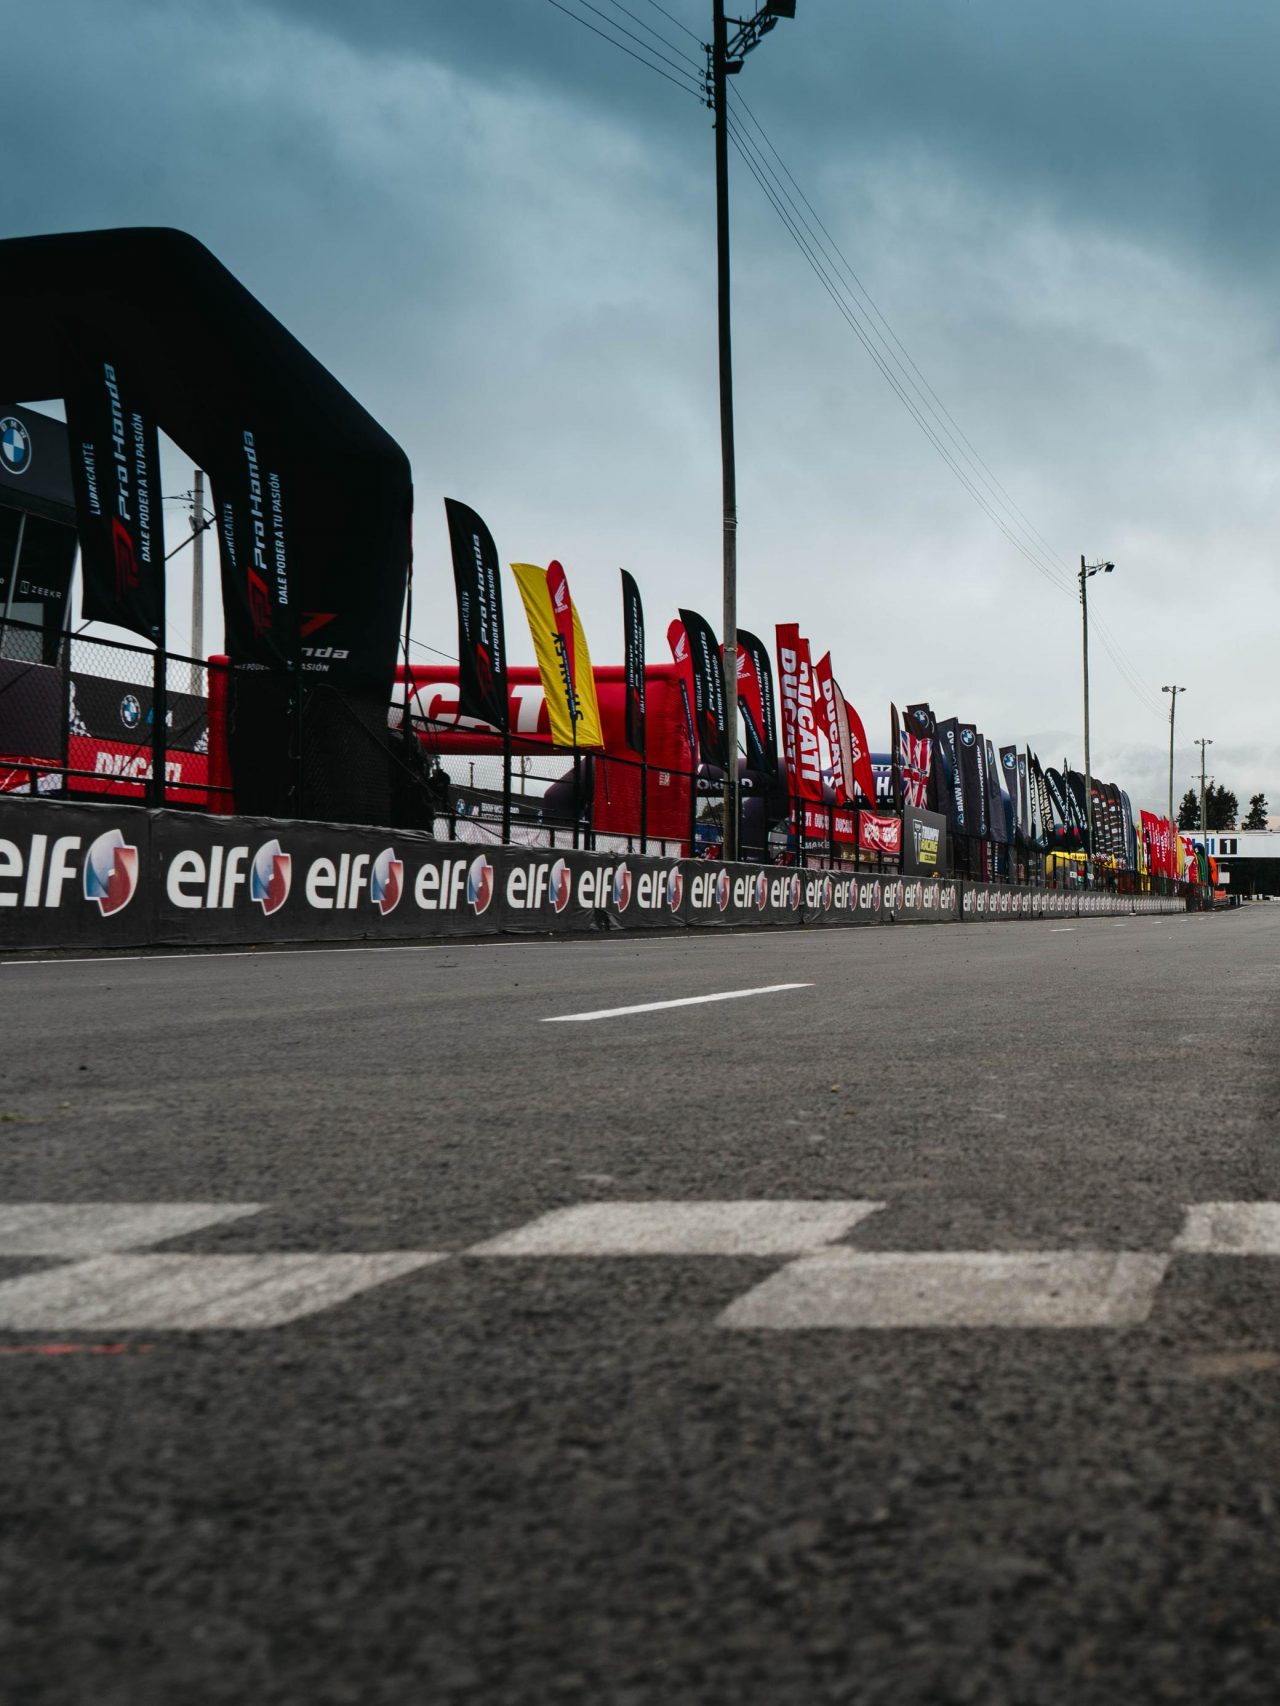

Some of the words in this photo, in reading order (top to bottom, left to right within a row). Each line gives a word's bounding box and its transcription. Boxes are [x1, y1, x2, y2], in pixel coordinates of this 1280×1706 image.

[103, 362, 127, 462] Honda
[130, 413, 146, 459] PASIÓN
[82, 442, 101, 515] LUBRICANTE
[136, 461, 147, 476] TU
[243, 430, 263, 518] Honda
[138, 488, 150, 530] PODER
[268, 473, 282, 513] PASIÓN
[223, 502, 237, 567] BRICANTE
[273, 514, 283, 528] TU
[140, 531, 152, 563] DALE
[275, 540, 286, 576] PODER
[31, 585, 62, 599] ZEEKR
[277, 577, 289, 605] DALE
[487, 568, 496, 600] PASIÓN
[492, 620, 500, 650] PODER
[94, 751, 182, 790] DUCTI
[167, 846, 248, 909] elf
[305, 853, 370, 909] elf
[414, 859, 467, 910] elf
[506, 863, 549, 909] elf
[578, 867, 613, 909] elf
[637, 870, 667, 909] elf
[690, 872, 716, 908] elf
[733, 874, 756, 908] elf
[770, 876, 790, 908] elf
[806, 879, 823, 909] elf
[834, 880, 849, 909] elf
